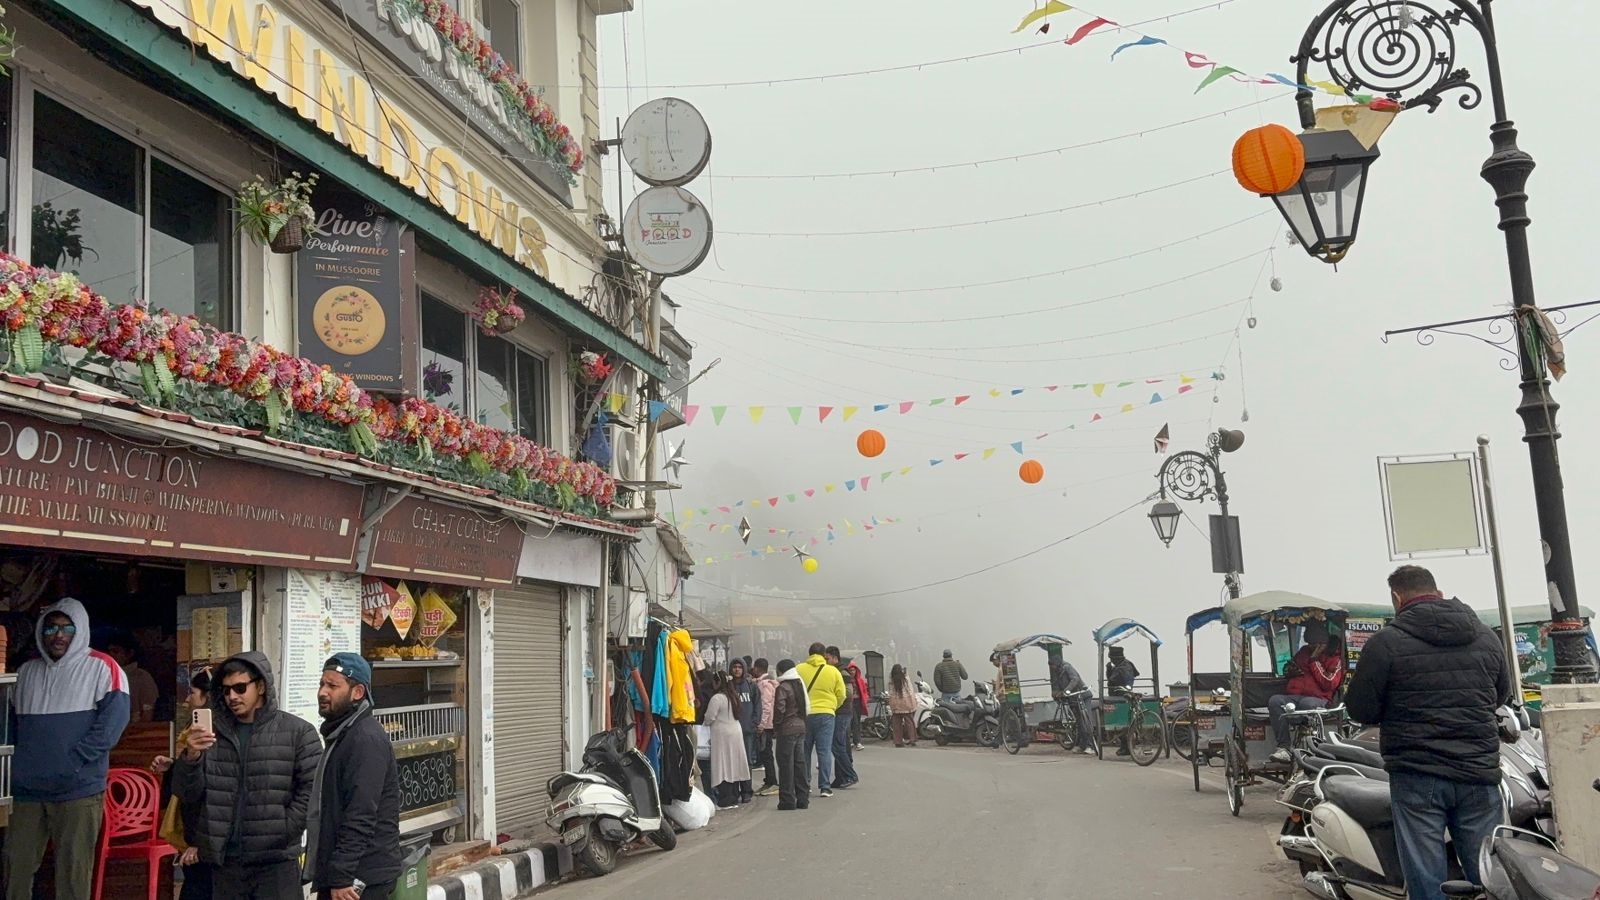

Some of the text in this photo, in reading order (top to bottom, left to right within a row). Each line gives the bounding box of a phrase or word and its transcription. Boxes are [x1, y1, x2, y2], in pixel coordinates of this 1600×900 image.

[186, 0, 551, 282] WINDOWS
[314, 208, 374, 238] Live
[306, 237, 390, 257] Performance
[315, 263, 381, 276] IN MUSSOORIE
[355, 373, 394, 382] WINDOWS
[69, 437, 202, 488] JUNCTION
[64, 476, 91, 496] PAV
[159, 491, 233, 517] WHISPERING
[36, 500, 80, 522] MALL
[86, 505, 169, 532] MUSSOORIE
[456, 516, 500, 544] CORNER
[1348, 623, 1379, 631] ISLAND
